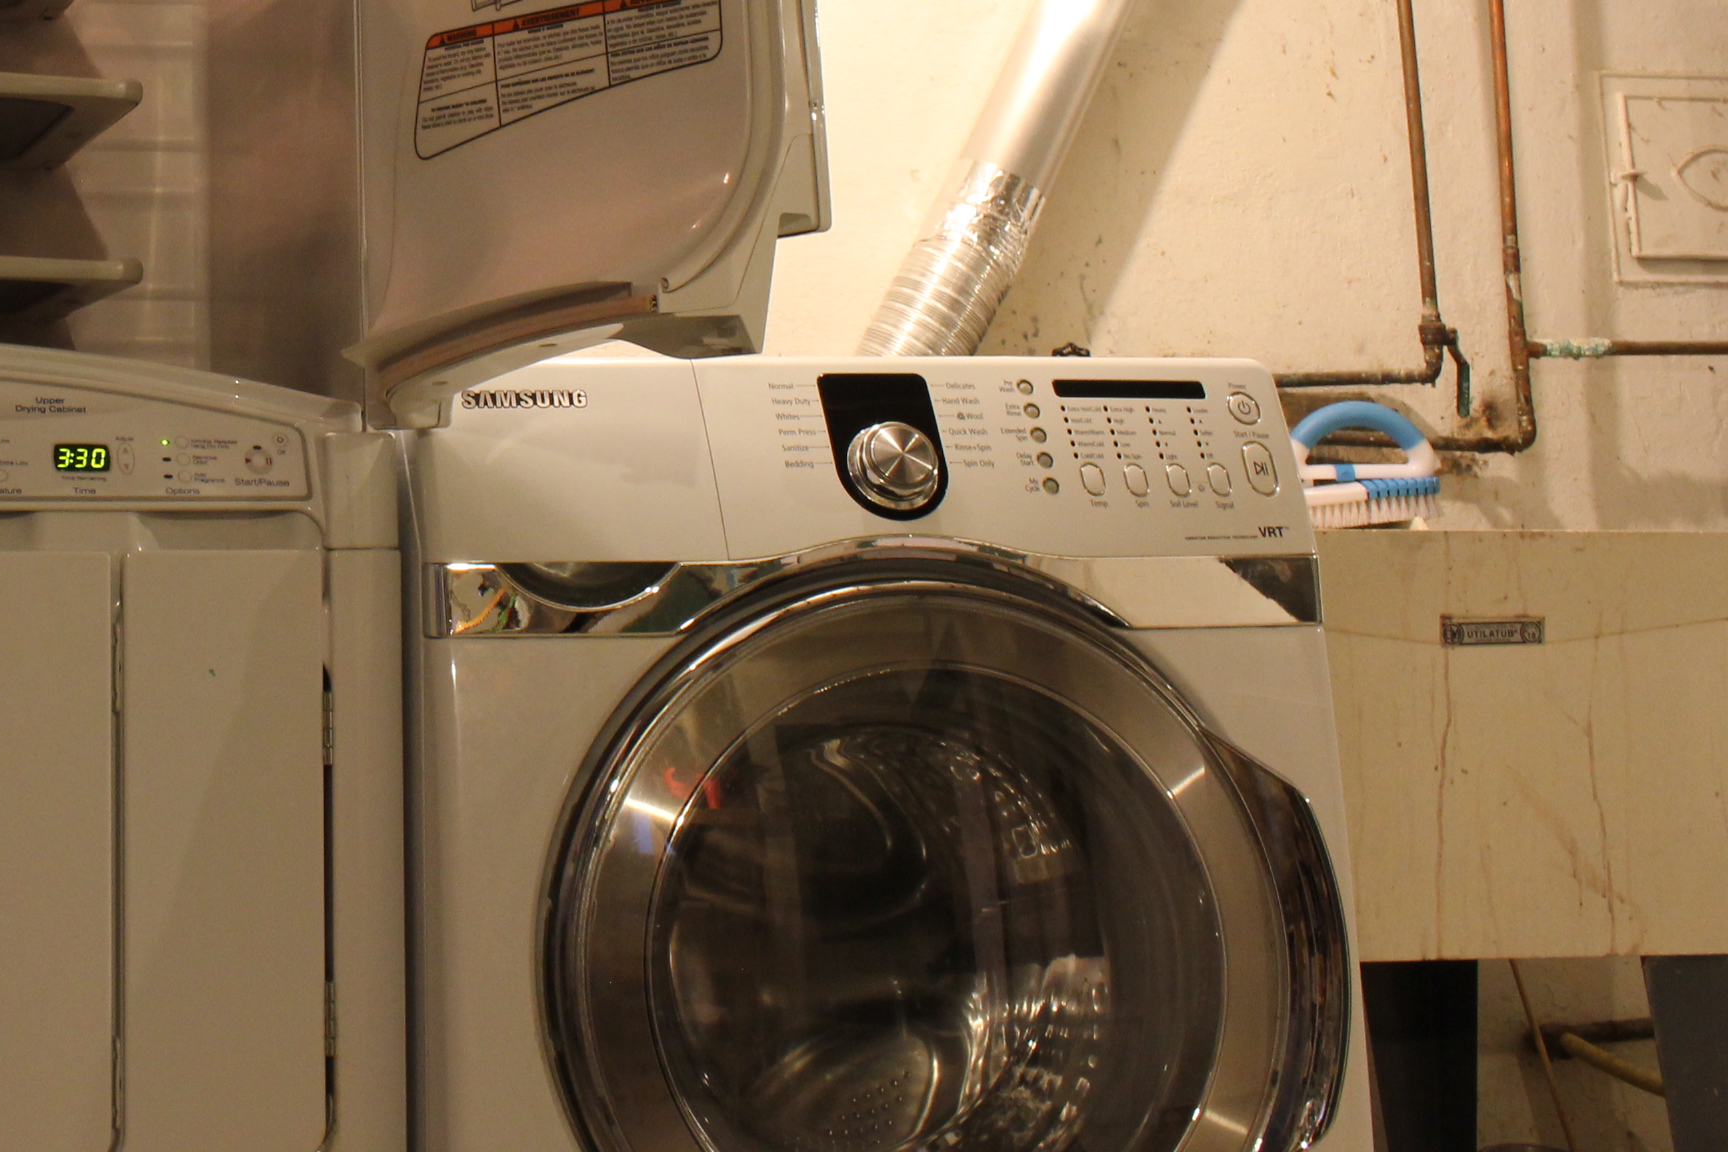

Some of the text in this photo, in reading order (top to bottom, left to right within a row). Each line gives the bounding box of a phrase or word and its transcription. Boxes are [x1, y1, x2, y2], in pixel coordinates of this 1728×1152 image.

[945, 382, 976, 390] Delicates
[35, 397, 65, 406] Upper
[461, 389, 589, 410] SAMSUNG
[771, 398, 793, 406] Heavy
[961, 397, 980, 405] Wash
[15, 405, 87, 415] Drying Cabinet
[775, 413, 800, 421] Whites
[965, 412, 984, 420] Wool
[797, 428, 817, 437] Press
[949, 428, 988, 436] Quick Wash
[782, 443, 810, 452] Sanitize
[57, 448, 106, 469] 3:30
[784, 460, 814, 469] Bedding
[963, 459, 995, 469] Spin Only
[234, 477, 291, 488] Start/Pause
[73, 487, 97, 495] Time
[165, 487, 201, 497] Options
